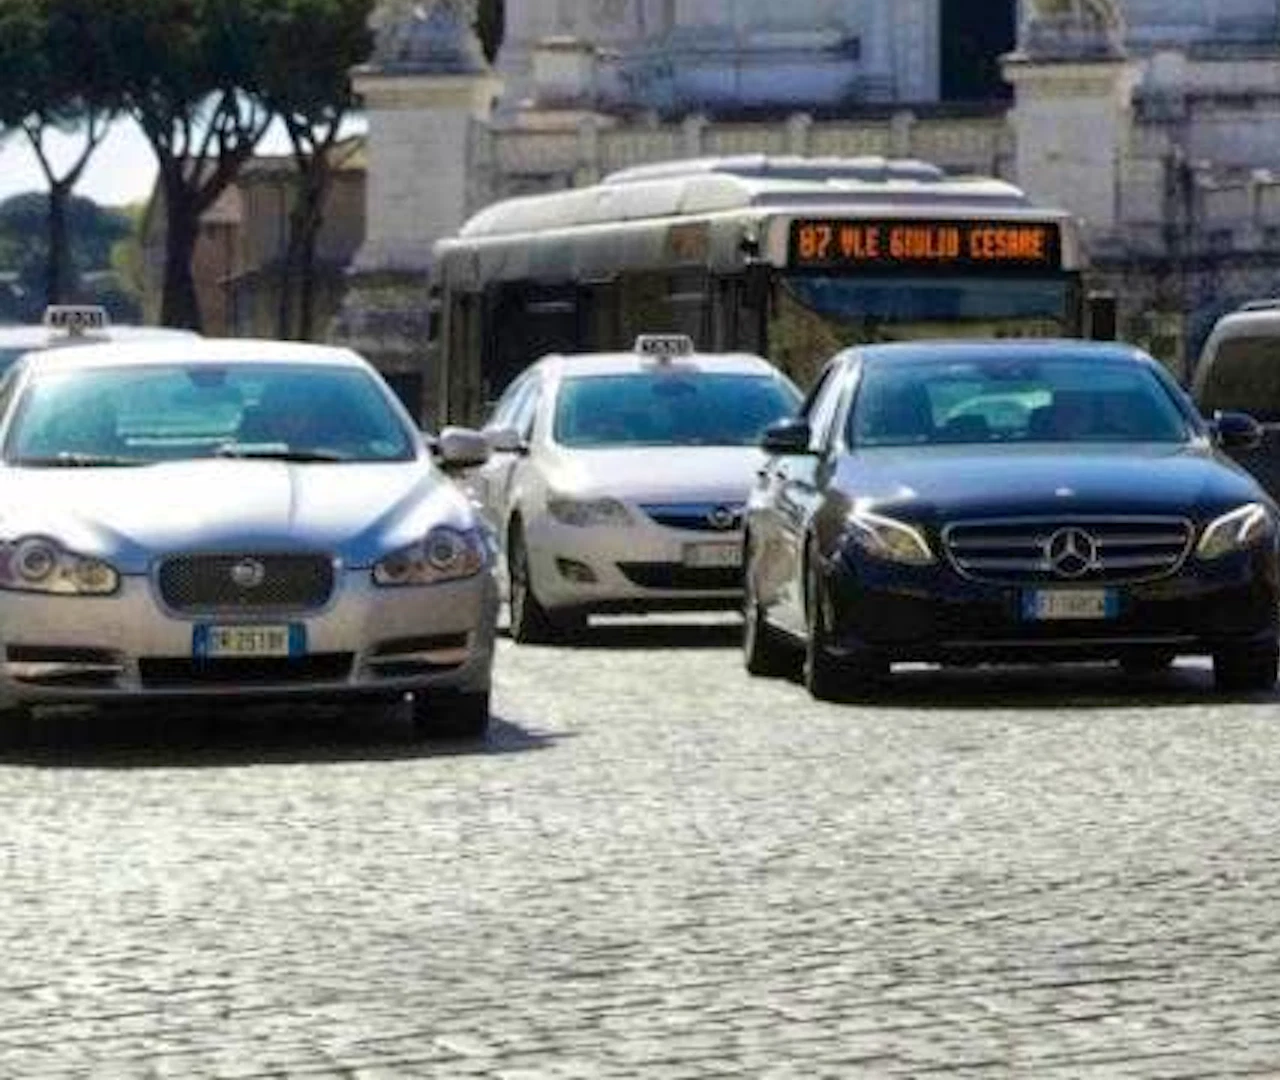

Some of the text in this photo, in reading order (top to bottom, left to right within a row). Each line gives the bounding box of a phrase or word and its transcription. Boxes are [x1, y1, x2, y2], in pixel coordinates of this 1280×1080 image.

[799, 225, 832, 259] 87
[840, 225, 880, 259] VLE
[969, 226, 1045, 260] CESARE
